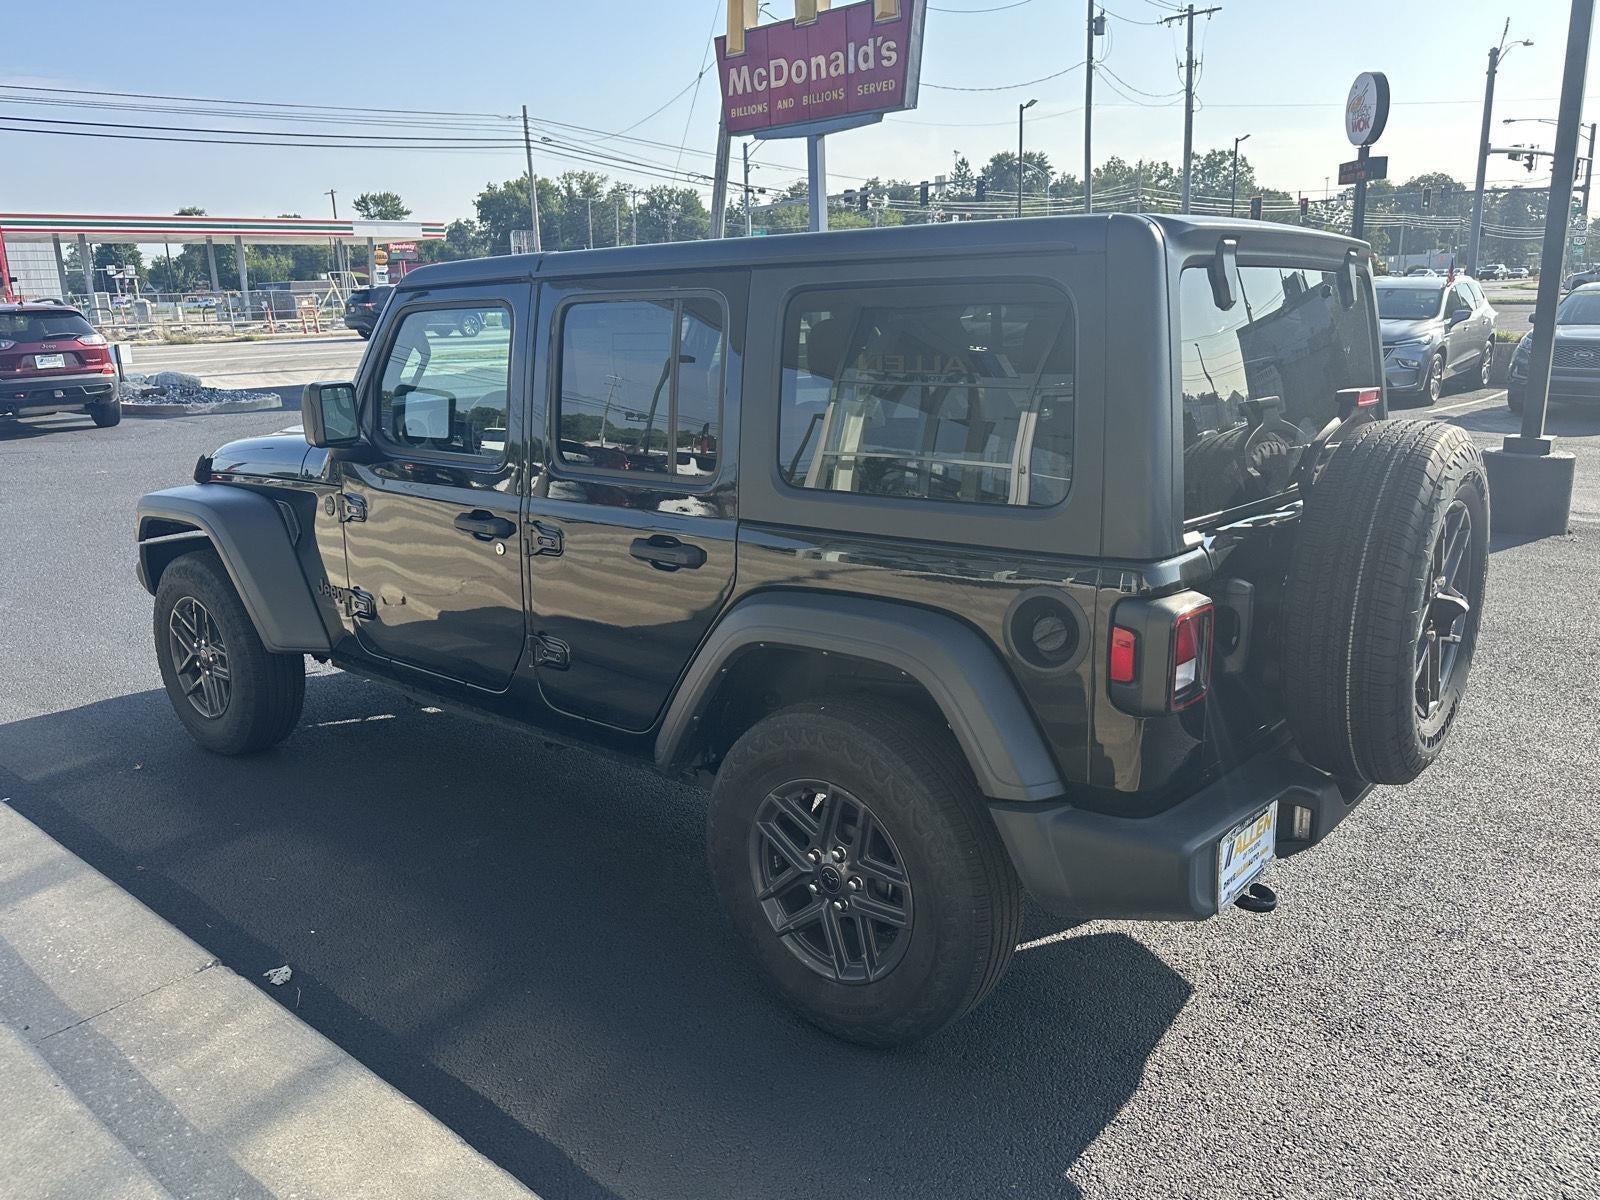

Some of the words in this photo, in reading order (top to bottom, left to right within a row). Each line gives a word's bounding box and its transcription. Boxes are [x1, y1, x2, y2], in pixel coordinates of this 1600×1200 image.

[728, 36, 898, 97] McDonald's
[731, 102, 768, 118] BILLIONS
[776, 98, 795, 111] AND
[802, 88, 845, 106] BILLIONS
[857, 79, 896, 96] SERVED
[318, 578, 344, 603] Jeep
[1235, 812, 1272, 856] ALLEN
